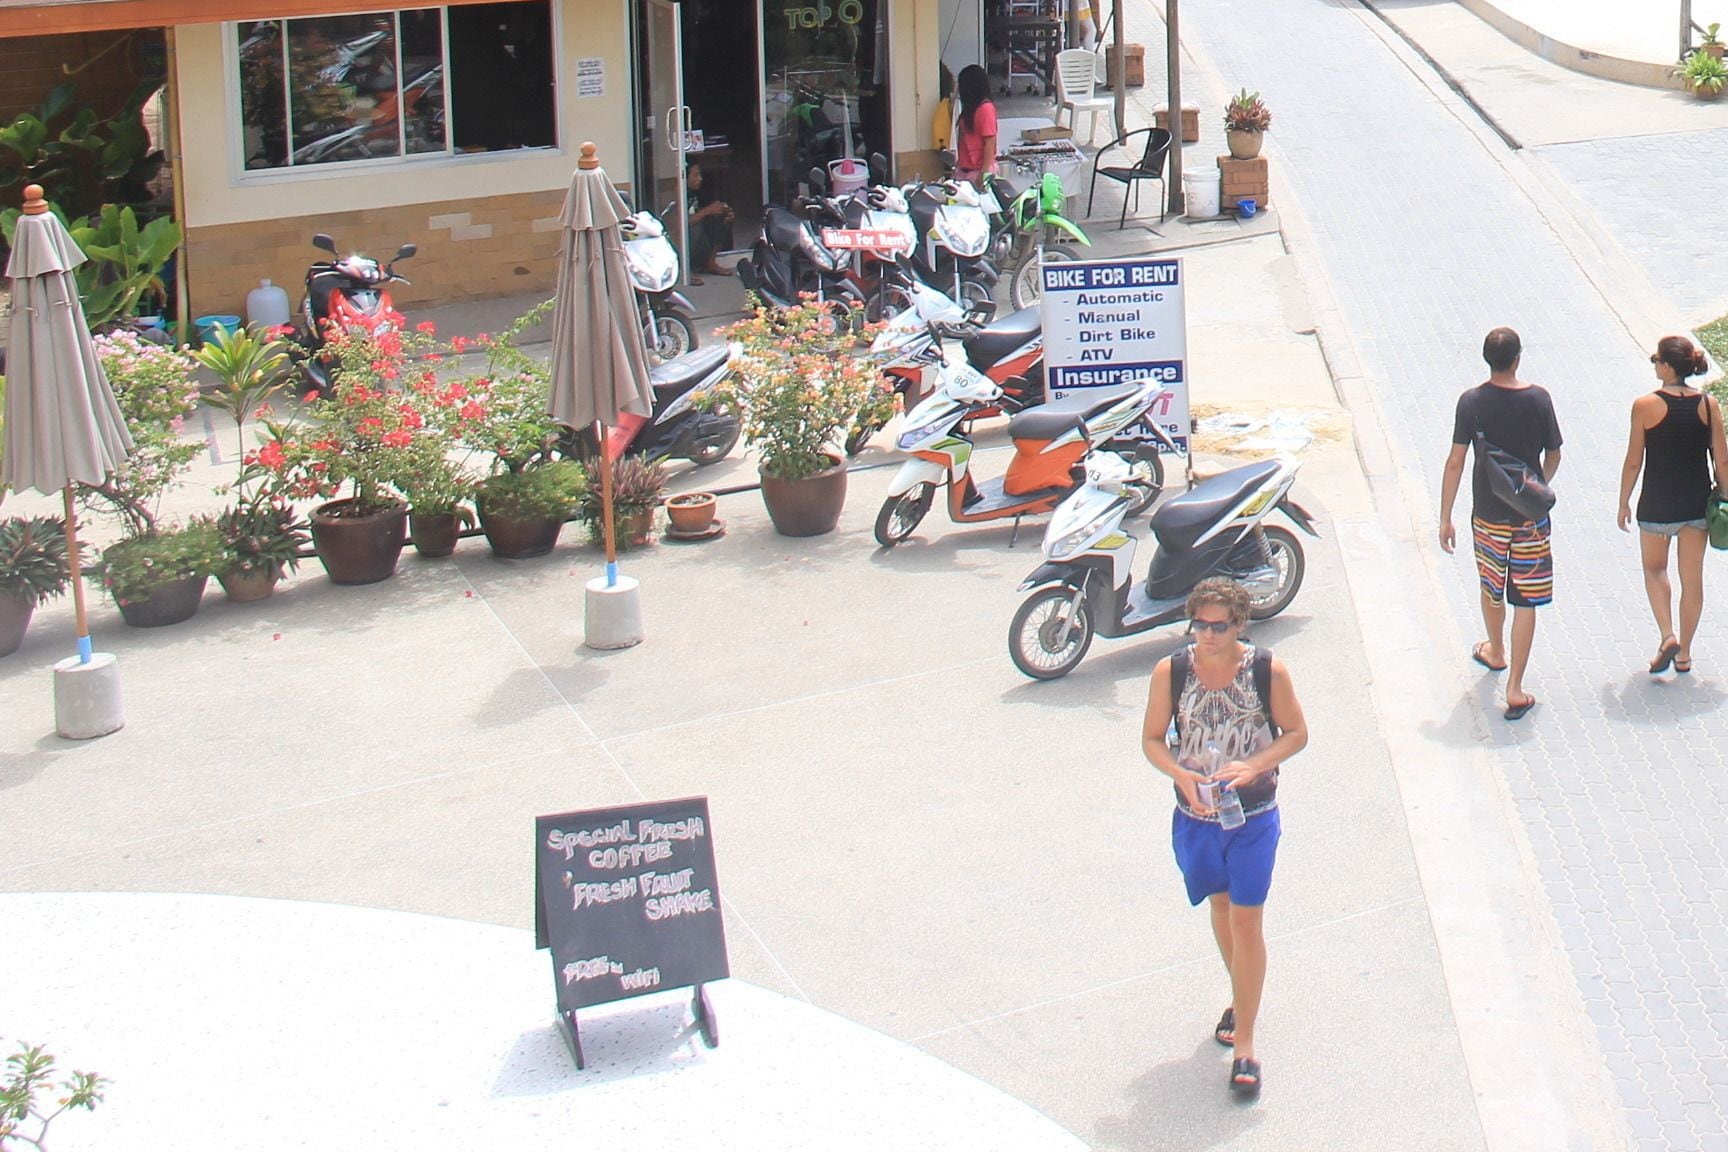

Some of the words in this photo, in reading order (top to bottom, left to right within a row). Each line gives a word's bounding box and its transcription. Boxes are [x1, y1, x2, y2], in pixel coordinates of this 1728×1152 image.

[784, 7, 832, 30] TOP
[855, 233, 874, 245] For
[1046, 270, 1084, 288] BIKE
[1092, 268, 1125, 285] FOR
[1132, 265, 1177, 284] RENT
[1076, 290, 1164, 306] Automatic
[1078, 309, 1140, 324] Manual
[1080, 330, 1113, 343] Dirt
[1120, 328, 1156, 341] Bike
[1080, 348, 1114, 361] ATV
[1056, 366, 1177, 386] Insurance
[639, 816, 704, 843] FRESH
[589, 841, 673, 869] COFFEE
[572, 876, 637, 911] FRESH
[639, 868, 695, 897] FRUIT
[645, 888, 713, 920] SHAKE
